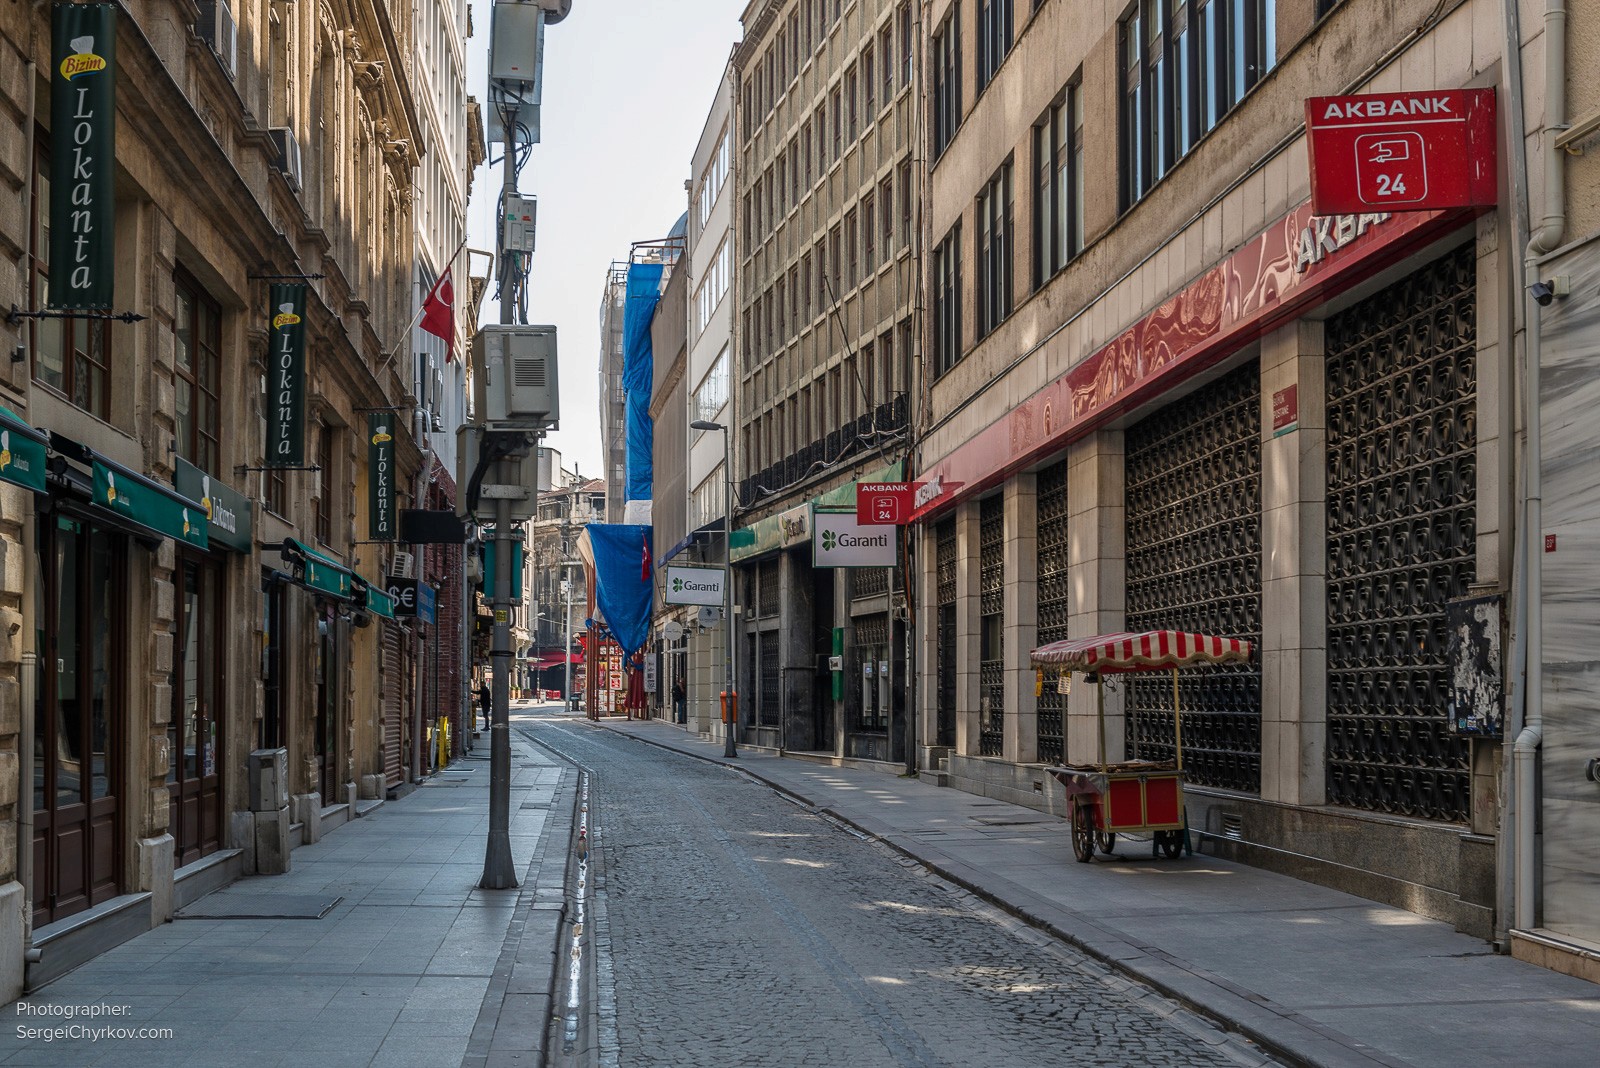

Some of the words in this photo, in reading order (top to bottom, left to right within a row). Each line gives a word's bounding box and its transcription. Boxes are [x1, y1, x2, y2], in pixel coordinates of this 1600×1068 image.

[65, 56, 103, 74] Bizim
[1323, 96, 1452, 120] AKBANK
[70, 88, 94, 289] Lokanta
[1376, 174, 1406, 196] 24
[275, 316, 298, 326] Bizim
[278, 333, 293, 455] Lokanta
[377, 447, 388, 532] Lokanta
[861, 484, 908, 492] AKBANK
[212, 496, 236, 535] Lokanta
[879, 510, 890, 519] 24
[838, 533, 888, 547] Garanti
[684, 580, 719, 593] Garanti
